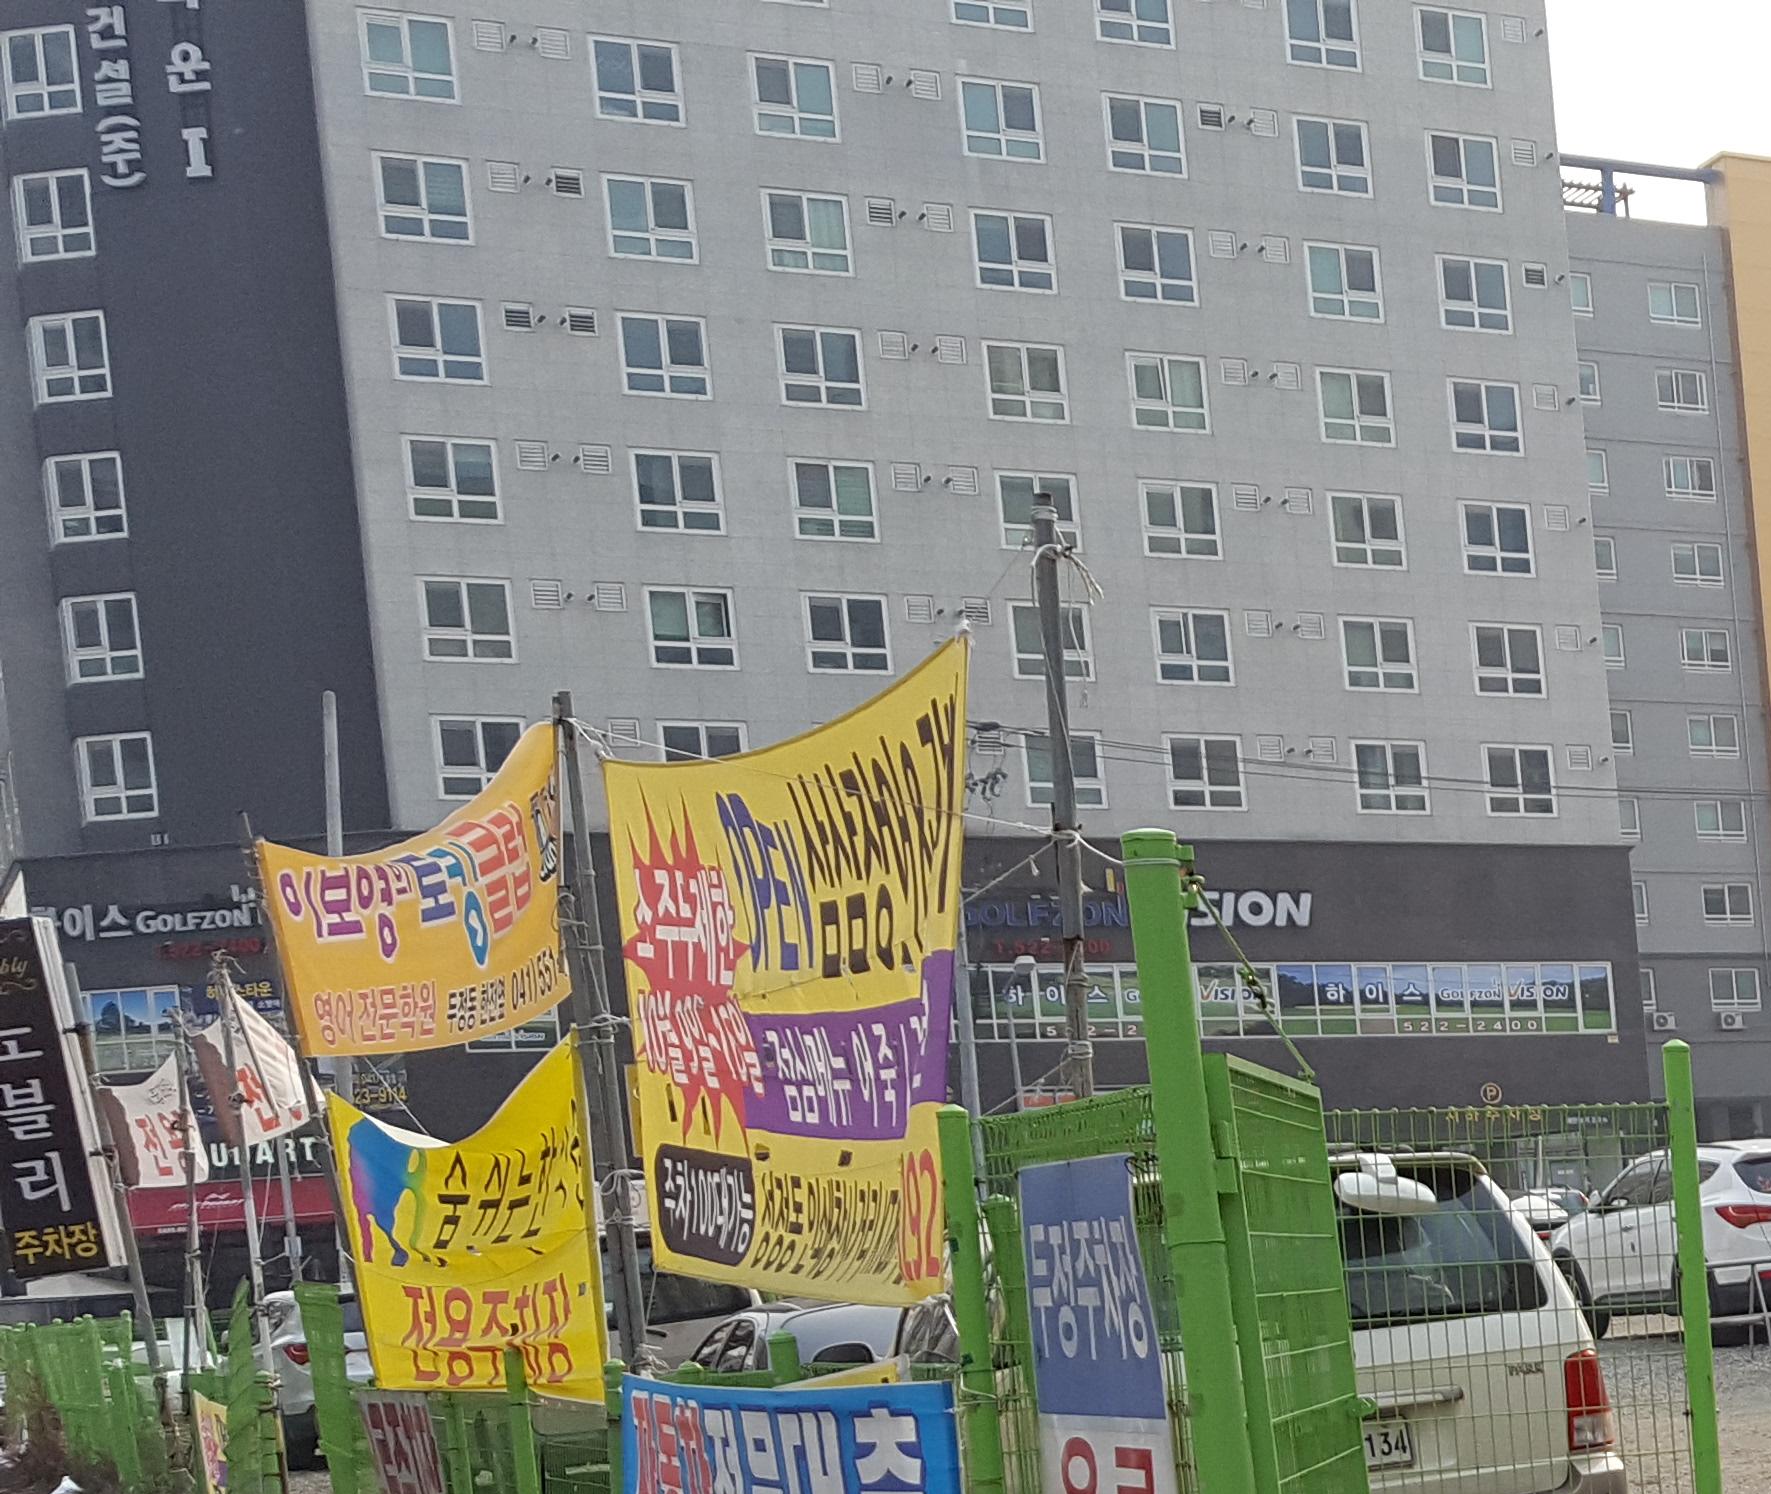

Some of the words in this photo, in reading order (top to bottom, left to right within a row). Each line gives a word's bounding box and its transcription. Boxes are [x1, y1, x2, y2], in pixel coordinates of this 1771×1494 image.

[715, 791, 815, 973] OPEN
[136, 904, 252, 934] GOLFZON
[1326, 982, 1423, 1005] 하이스
[313, 979, 436, 1046] 영어전문학원
[1403, 1018, 1538, 1033] 522-2400
[14, 1222, 100, 1265] 주차장
[401, 1272, 575, 1386] 전용주차장
[1364, 1428, 1408, 1458] 134
